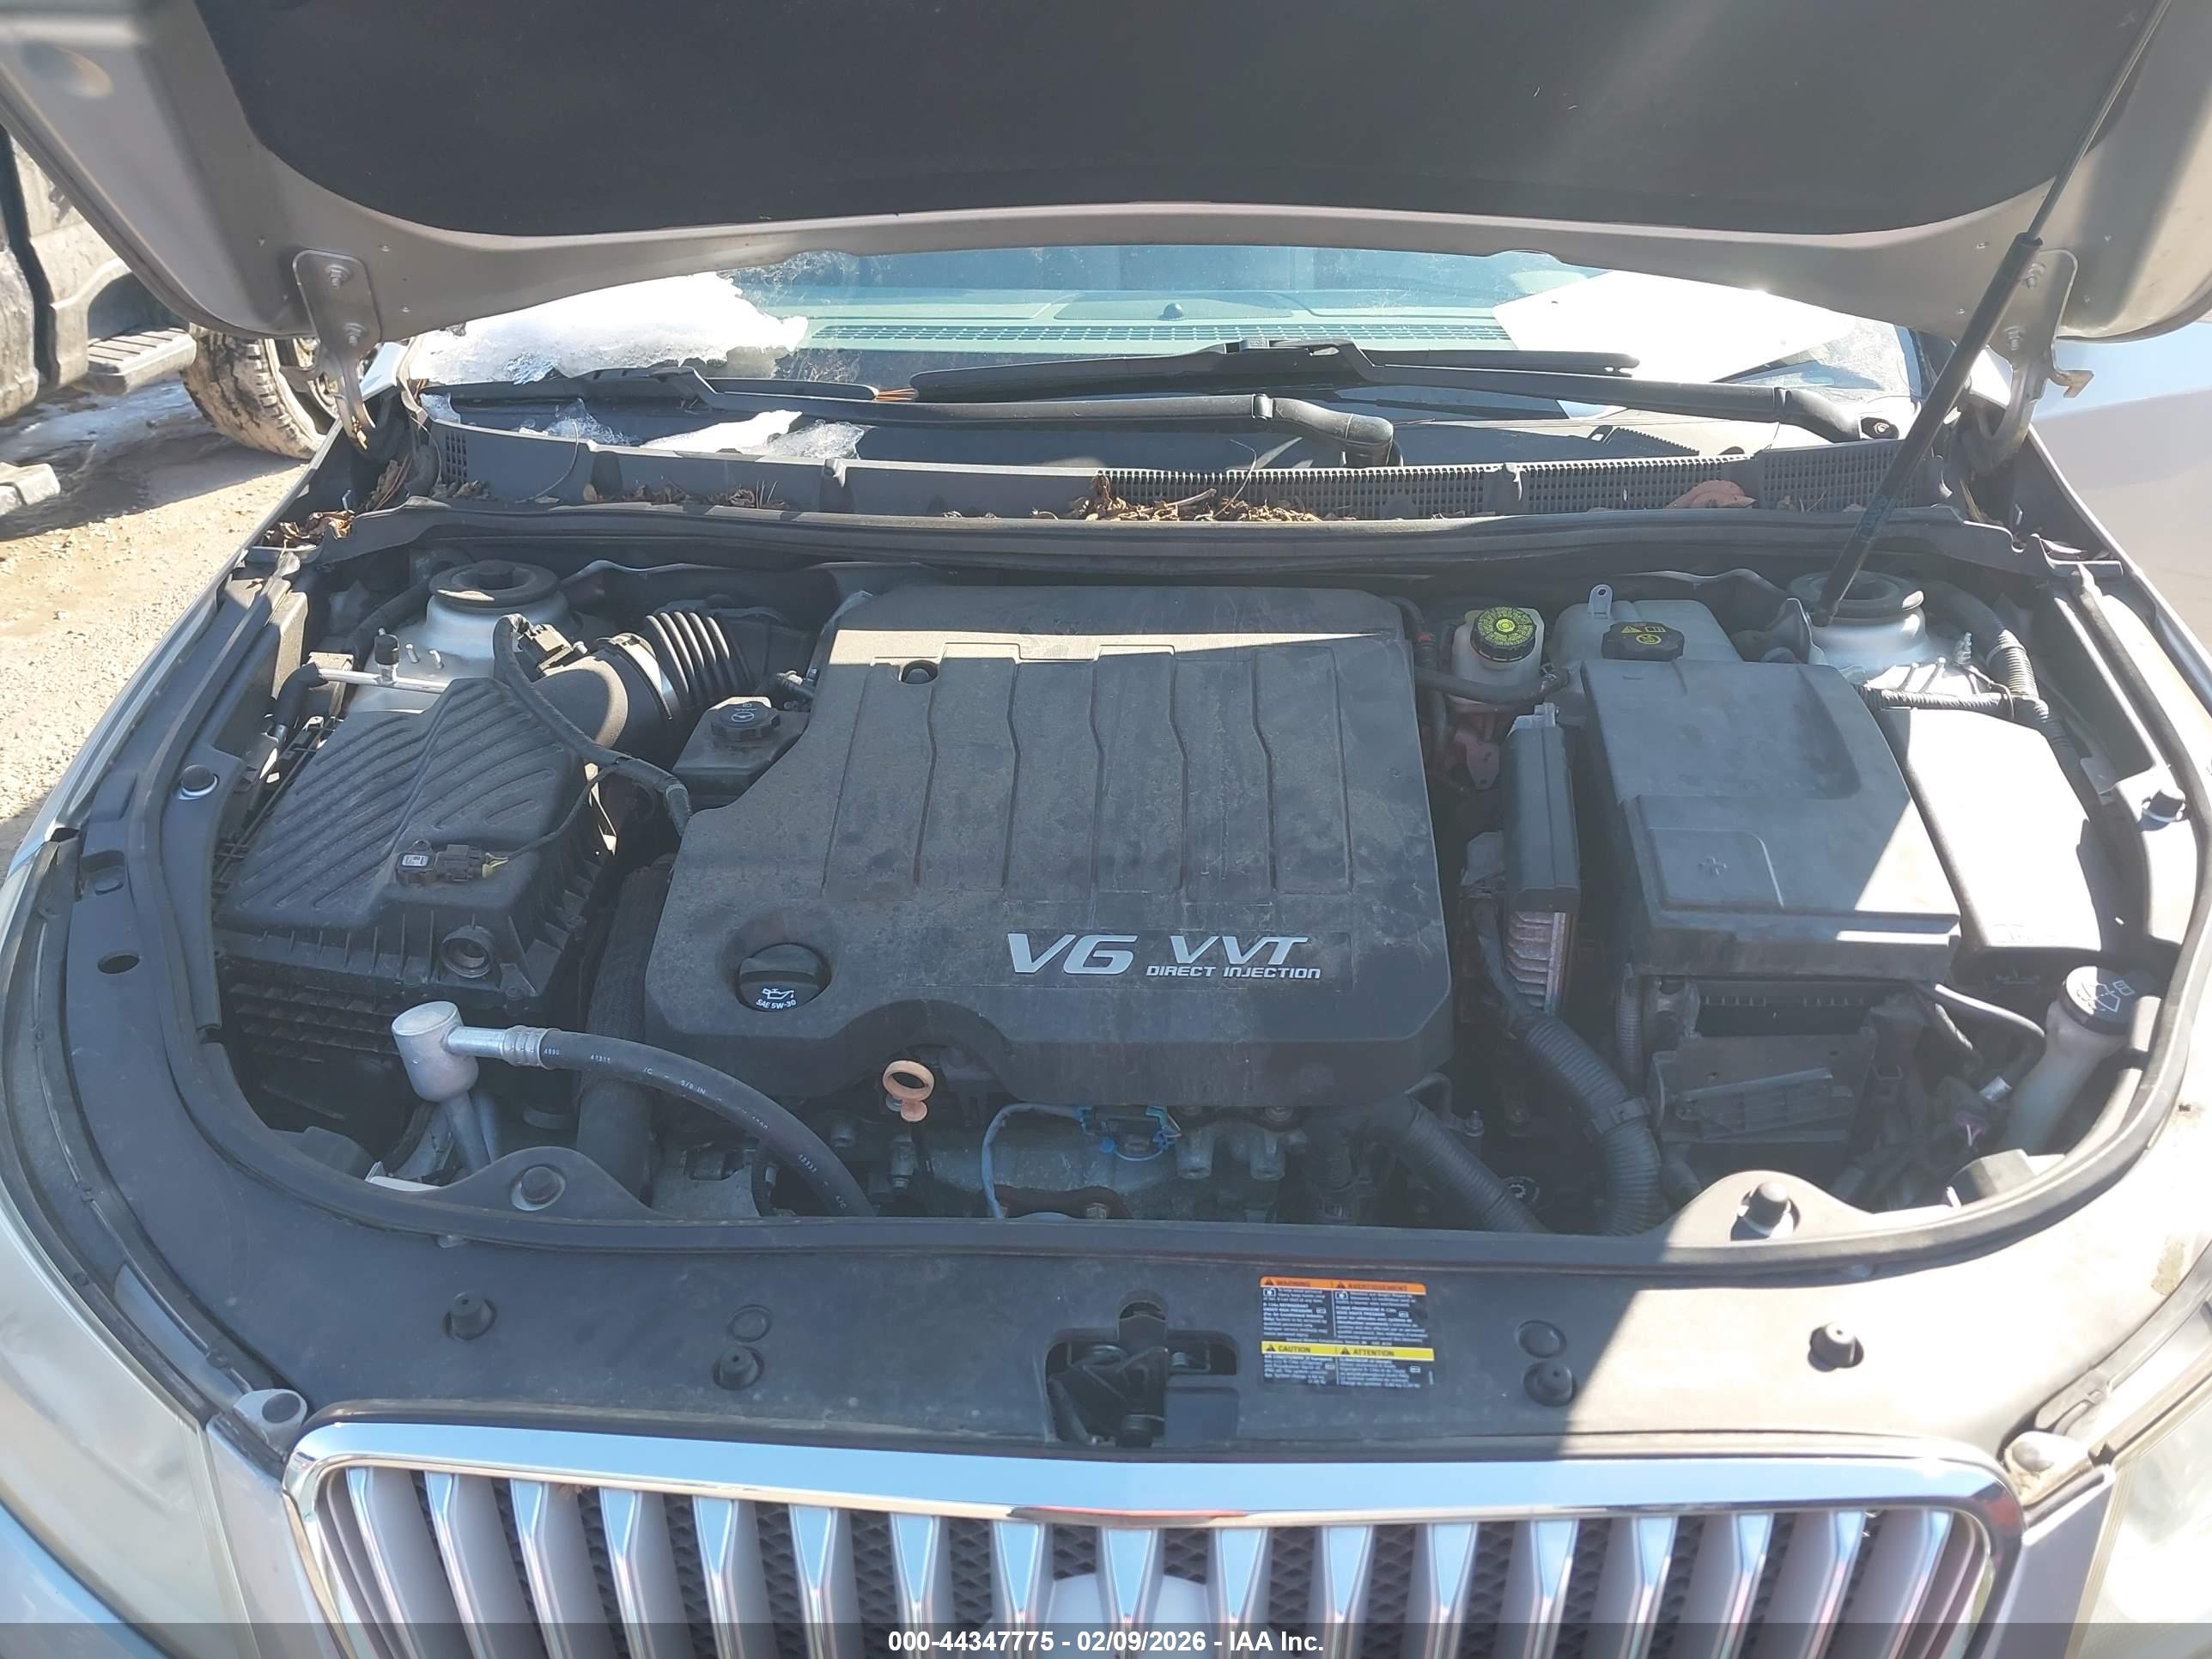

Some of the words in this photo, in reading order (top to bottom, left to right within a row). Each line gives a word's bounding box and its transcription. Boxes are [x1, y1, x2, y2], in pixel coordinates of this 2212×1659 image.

[1007, 933, 1139, 975] V6
[1170, 935, 1309, 965] VVT
[1146, 965, 1216, 978] DIRECT
[1223, 966, 1322, 980] INJECTION
[756, 999, 770, 1009] SAE
[771, 1000, 797, 1010] 5W-30
[1278, 1345, 1311, 1353] CAUTION
[1352, 1348, 1395, 1357] ATTENTION
